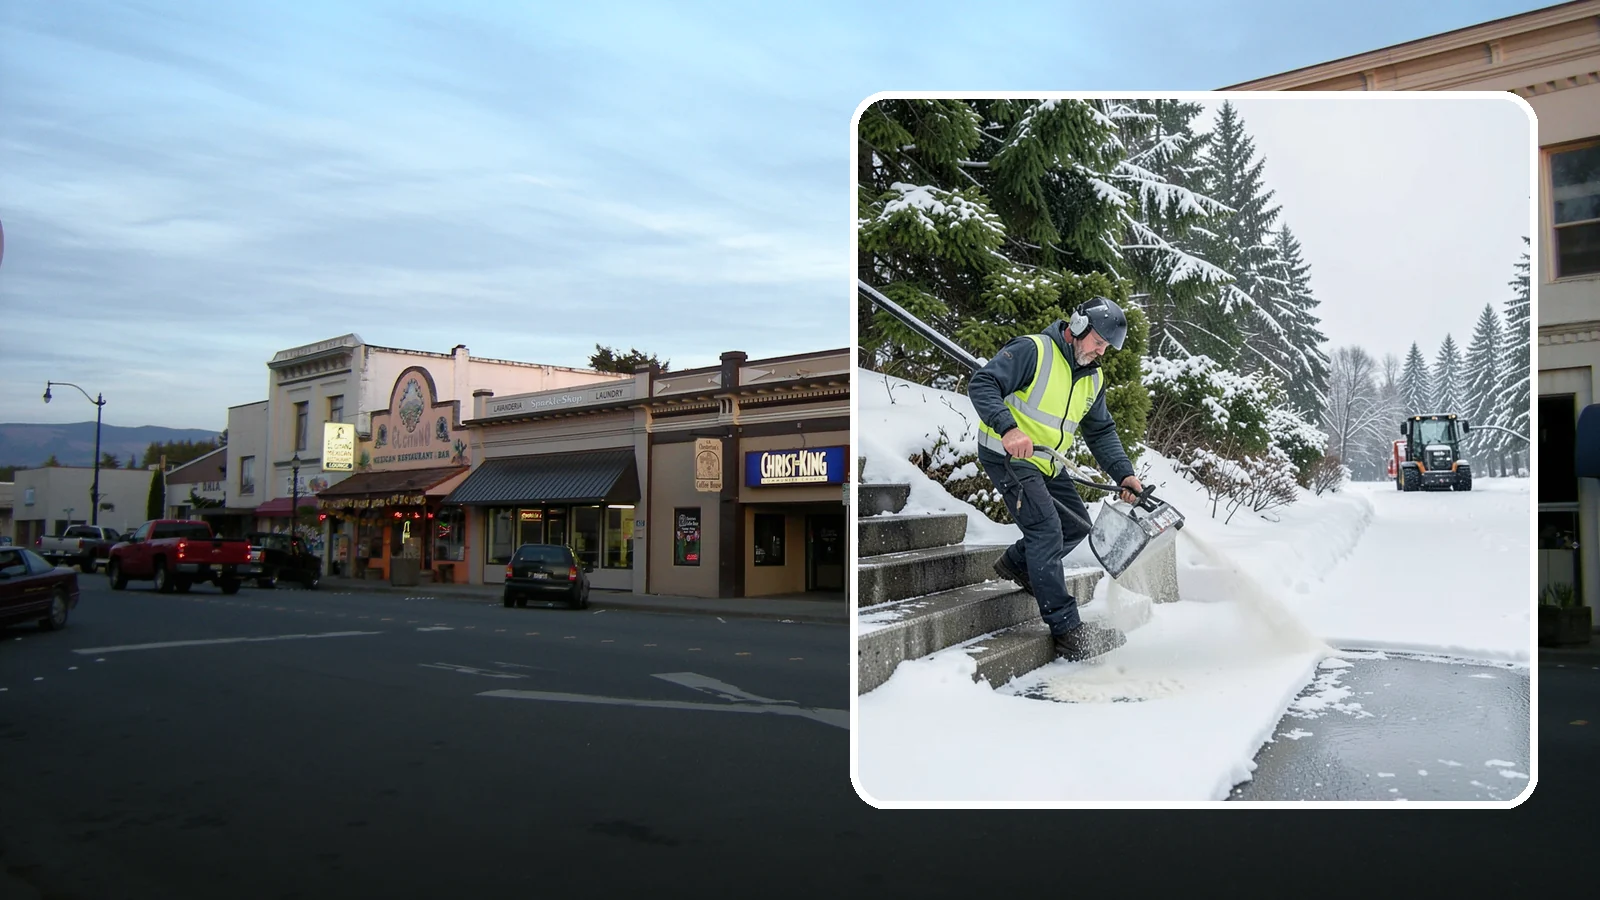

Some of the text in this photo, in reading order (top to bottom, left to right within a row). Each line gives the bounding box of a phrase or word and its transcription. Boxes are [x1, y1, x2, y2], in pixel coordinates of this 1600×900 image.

[494, 402, 522, 412] LAVANDERIA
[596, 389, 623, 399] LAUNDRY
[327, 450, 352, 458] MEXICAN
[373, 454, 396, 464] MEXICAN
[398, 451, 433, 462] RESTAURANT
[438, 450, 450, 459] BAR
[799, 450, 827, 476] KING
